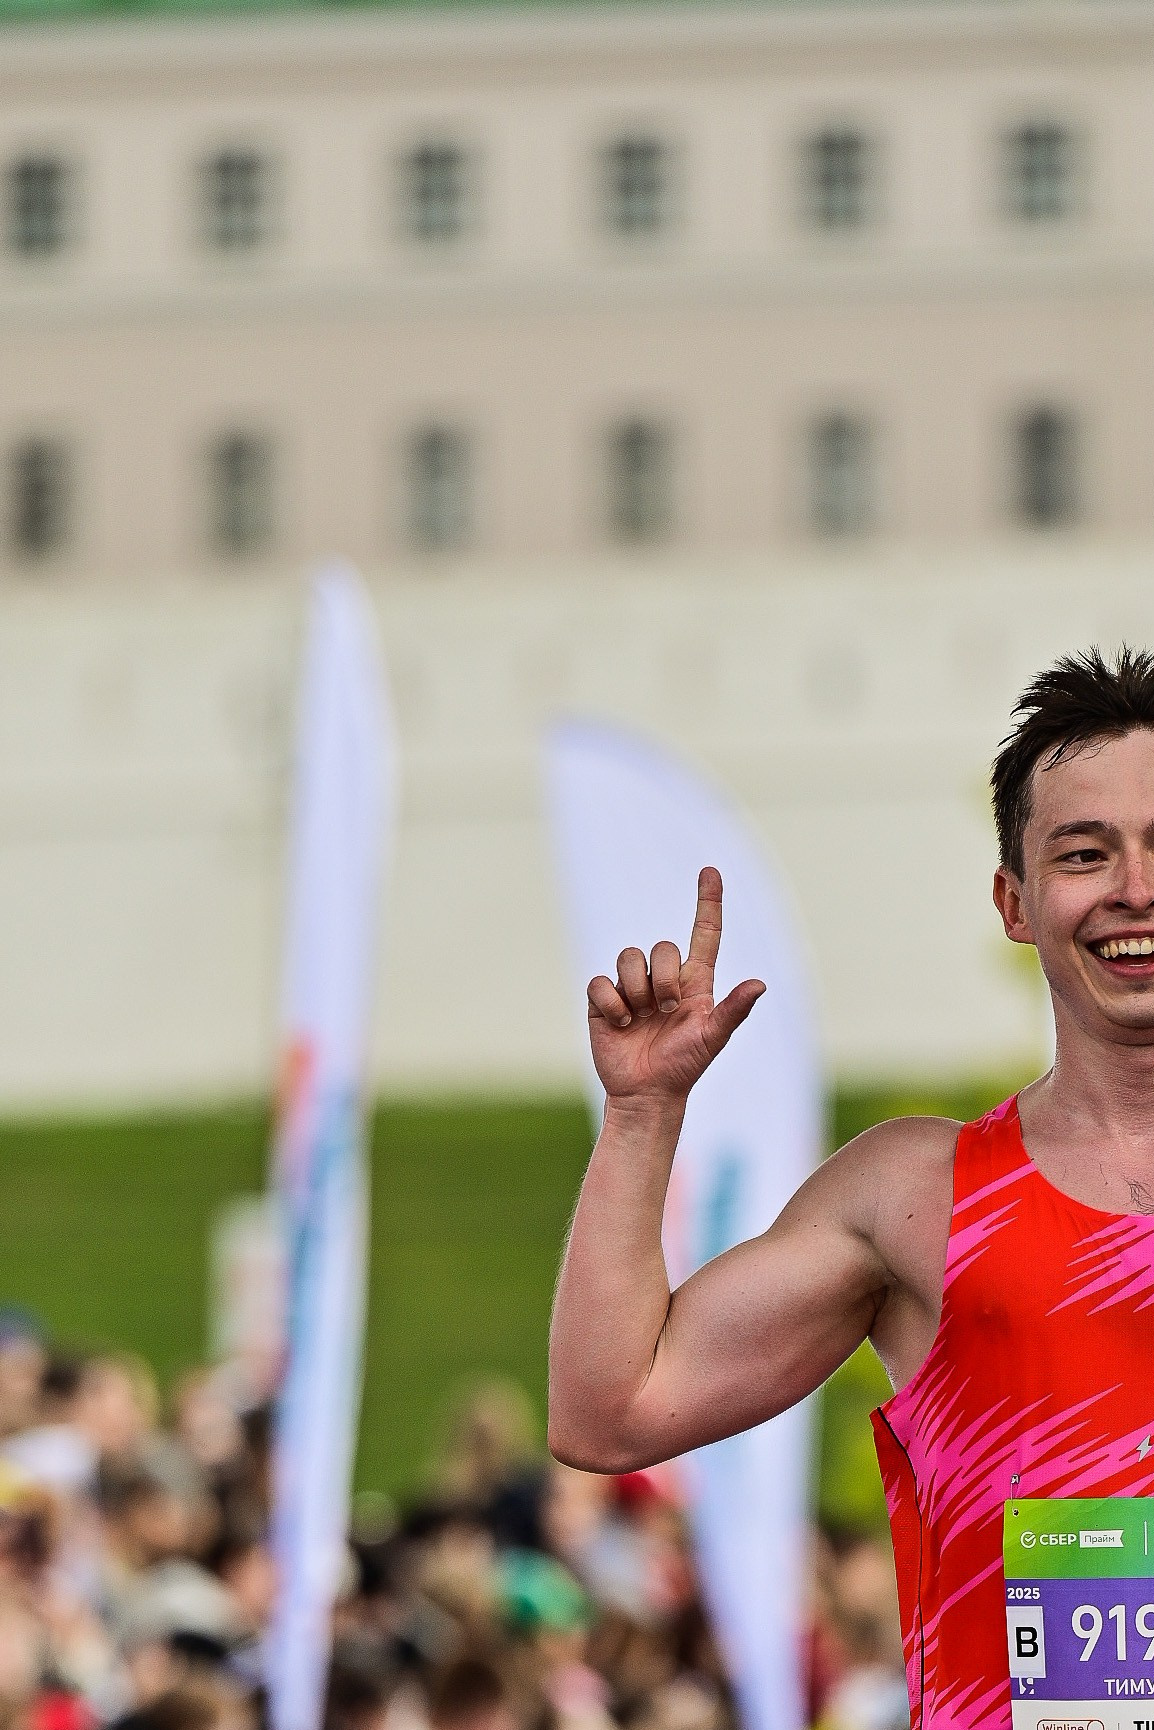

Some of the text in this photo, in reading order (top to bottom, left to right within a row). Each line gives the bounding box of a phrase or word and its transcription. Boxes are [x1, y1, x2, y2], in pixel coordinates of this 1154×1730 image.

[1039, 1533, 1115, 1546] СБЕР Прайм
[1006, 1587, 1041, 1600] 2025
